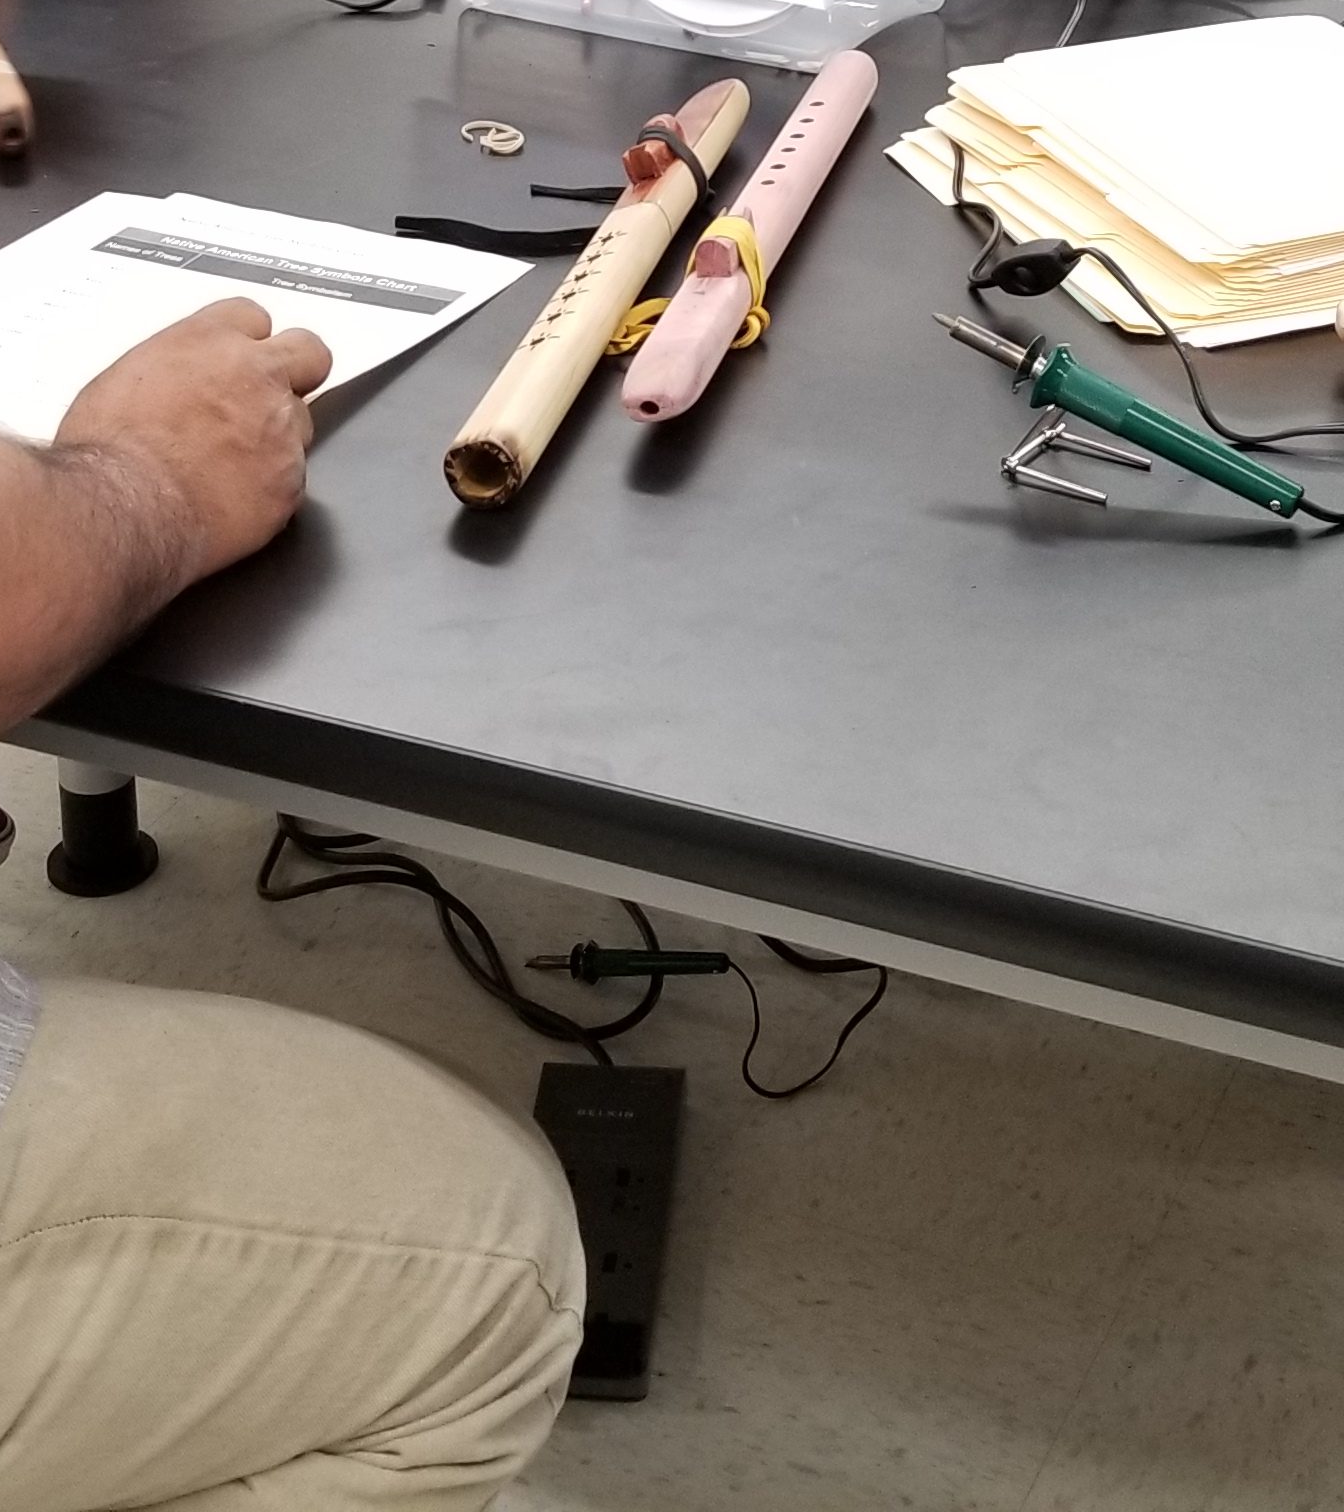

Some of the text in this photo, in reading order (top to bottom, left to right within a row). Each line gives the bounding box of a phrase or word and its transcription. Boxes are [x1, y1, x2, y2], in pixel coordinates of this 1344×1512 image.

[105, 241, 184, 263] Names of Trees
[160, 236, 418, 293] Native American Tree Symbols Chart
[271, 277, 295, 289] Tree
